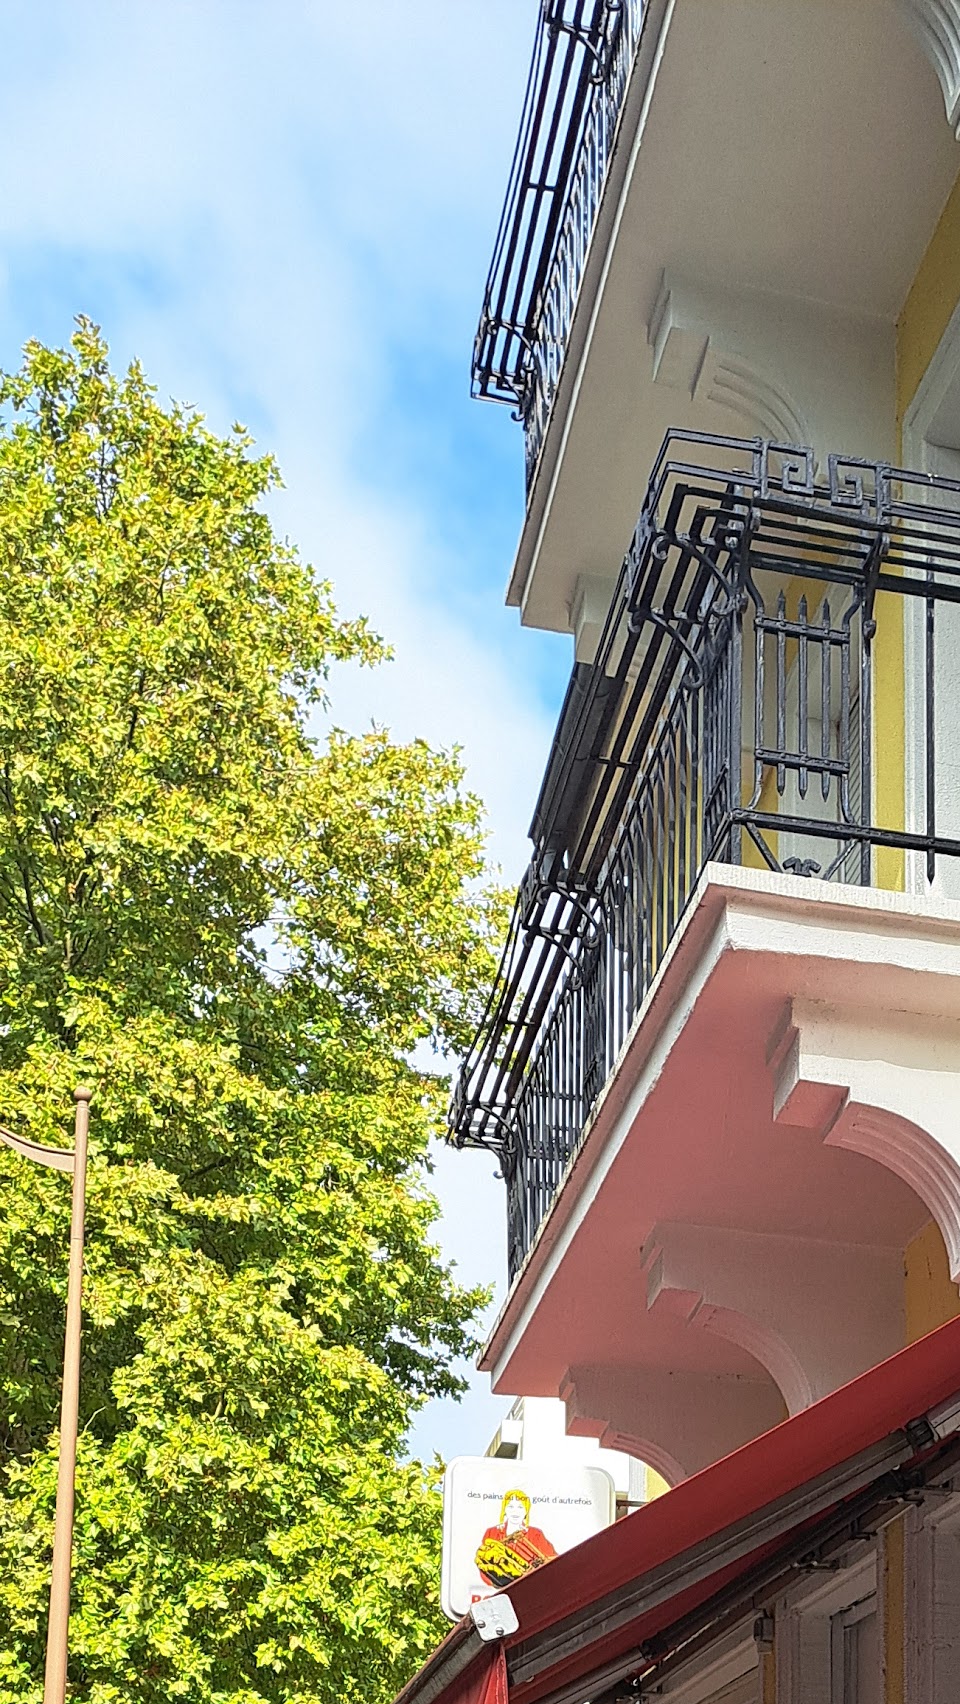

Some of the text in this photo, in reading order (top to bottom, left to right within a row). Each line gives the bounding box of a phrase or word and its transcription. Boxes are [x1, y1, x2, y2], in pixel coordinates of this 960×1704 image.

[467, 1491, 481, 1499] des
[483, 1493, 503, 1501] pains
[515, 1493, 530, 1502] bon
[552, 1497, 592, 1506] d'autrefois
